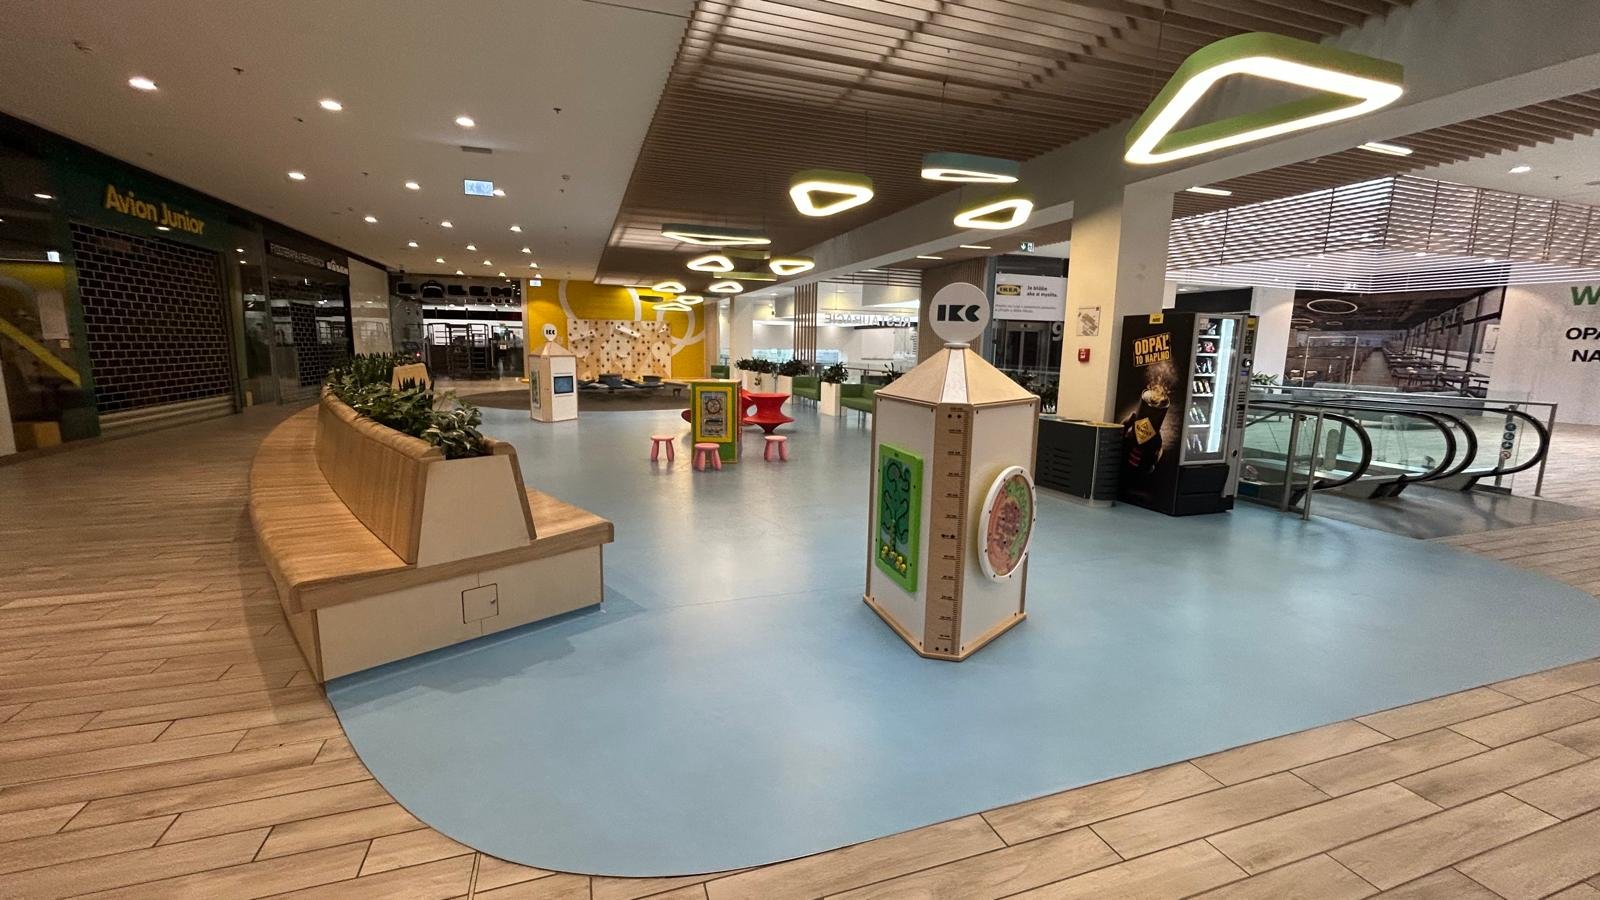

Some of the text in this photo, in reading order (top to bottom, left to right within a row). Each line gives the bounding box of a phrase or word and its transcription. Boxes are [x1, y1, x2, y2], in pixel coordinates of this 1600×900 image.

[105, 184, 204, 235] Avion Junior
[937, 304, 980, 322] IKC
[1136, 350, 1170, 364] TO NAPLNO
